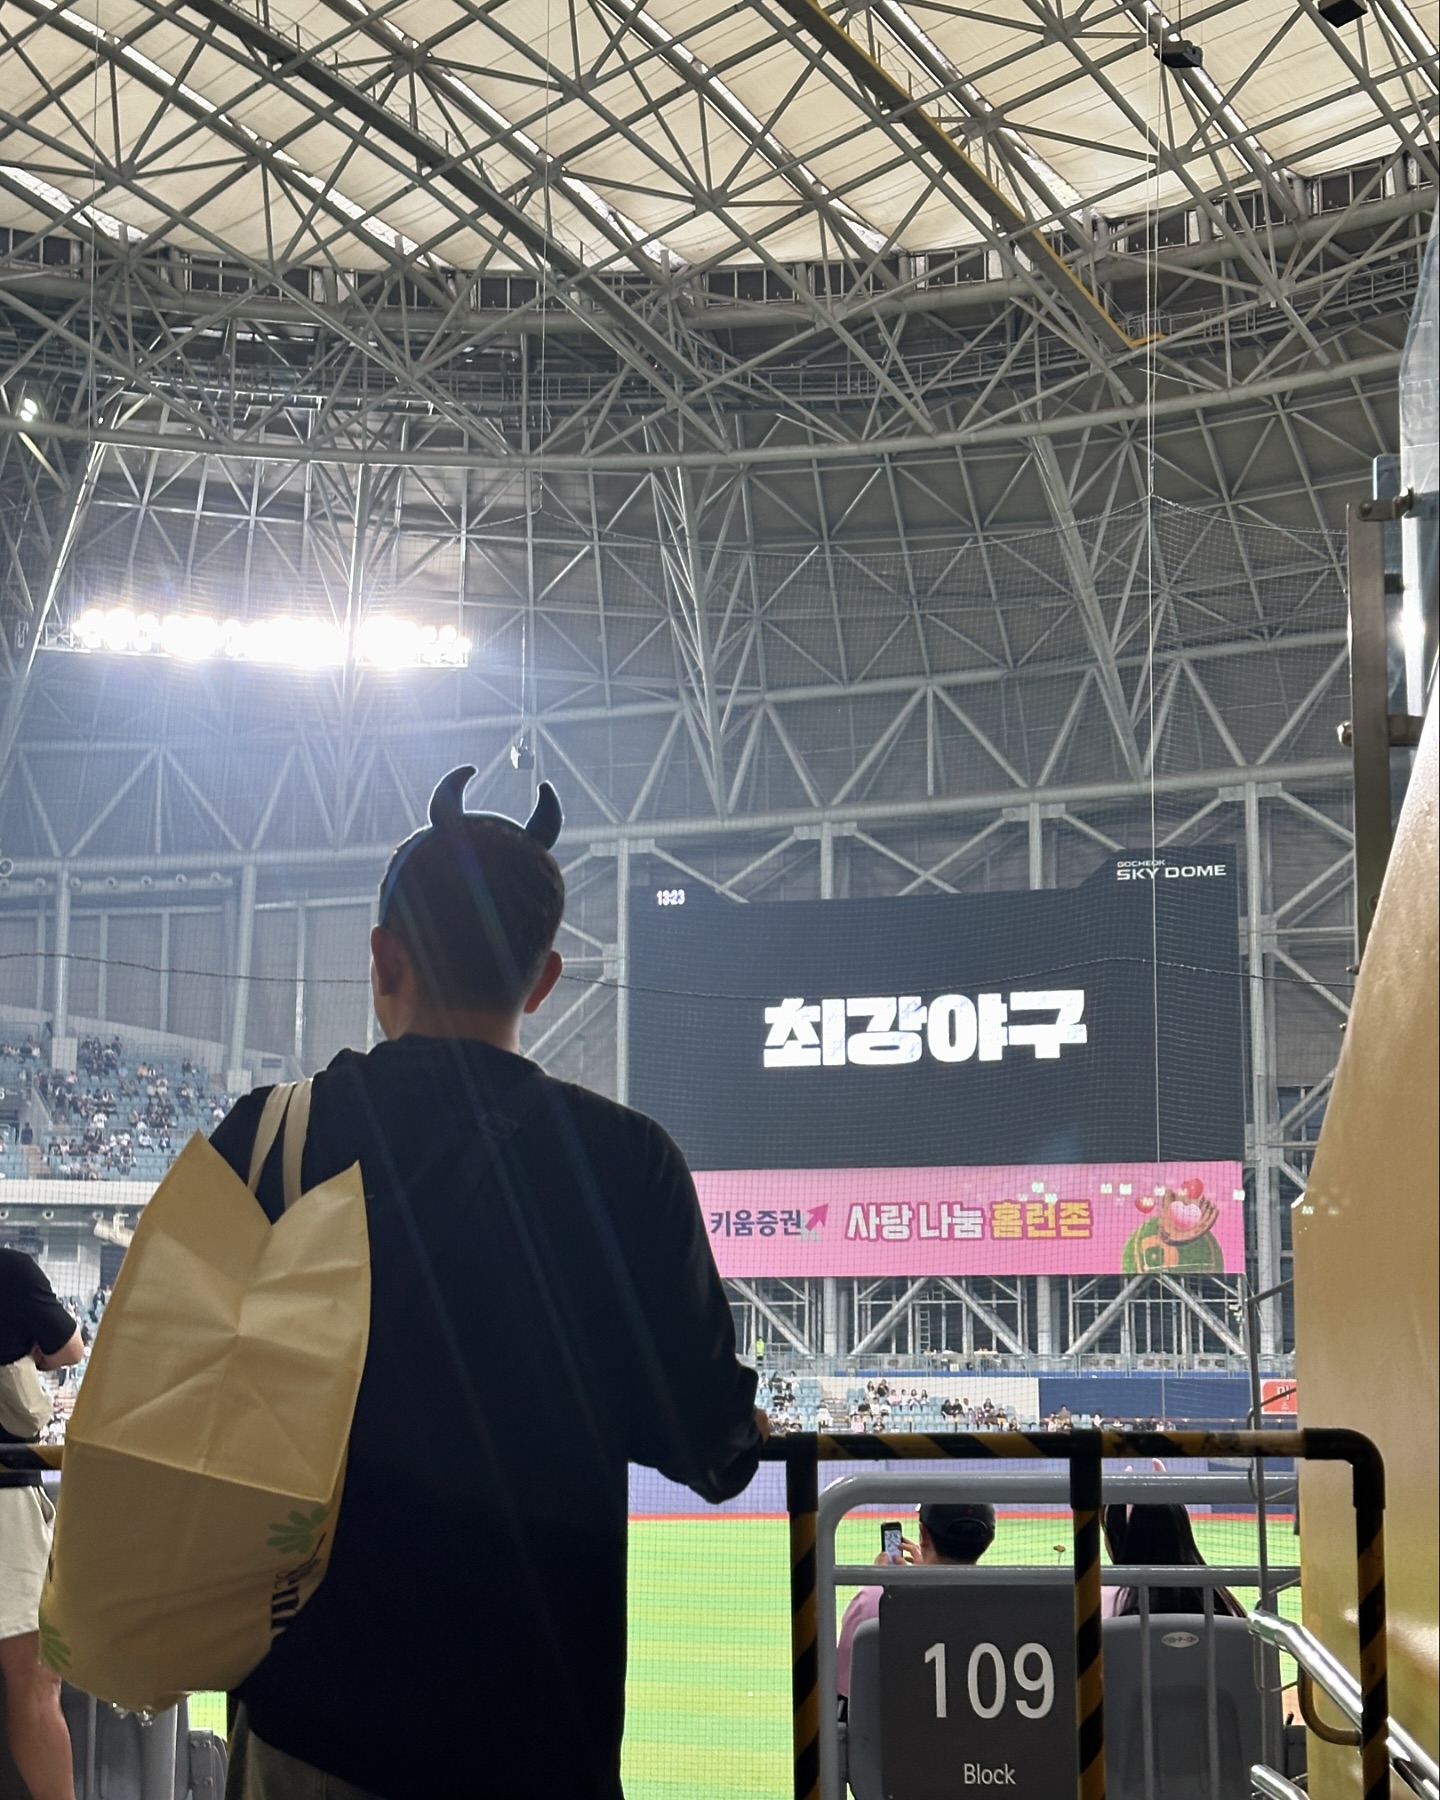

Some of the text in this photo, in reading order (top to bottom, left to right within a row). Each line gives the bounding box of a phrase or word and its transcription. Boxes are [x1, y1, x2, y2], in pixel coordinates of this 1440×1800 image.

[1117, 865, 1227, 880] SKY DOME
[763, 989, 1088, 1068] 최강야구
[710, 1201, 1092, 1240] 키움증권 사랑 나눔 홈런존
[924, 1642, 1055, 1720] 109
[963, 1763, 1017, 1785] Block
